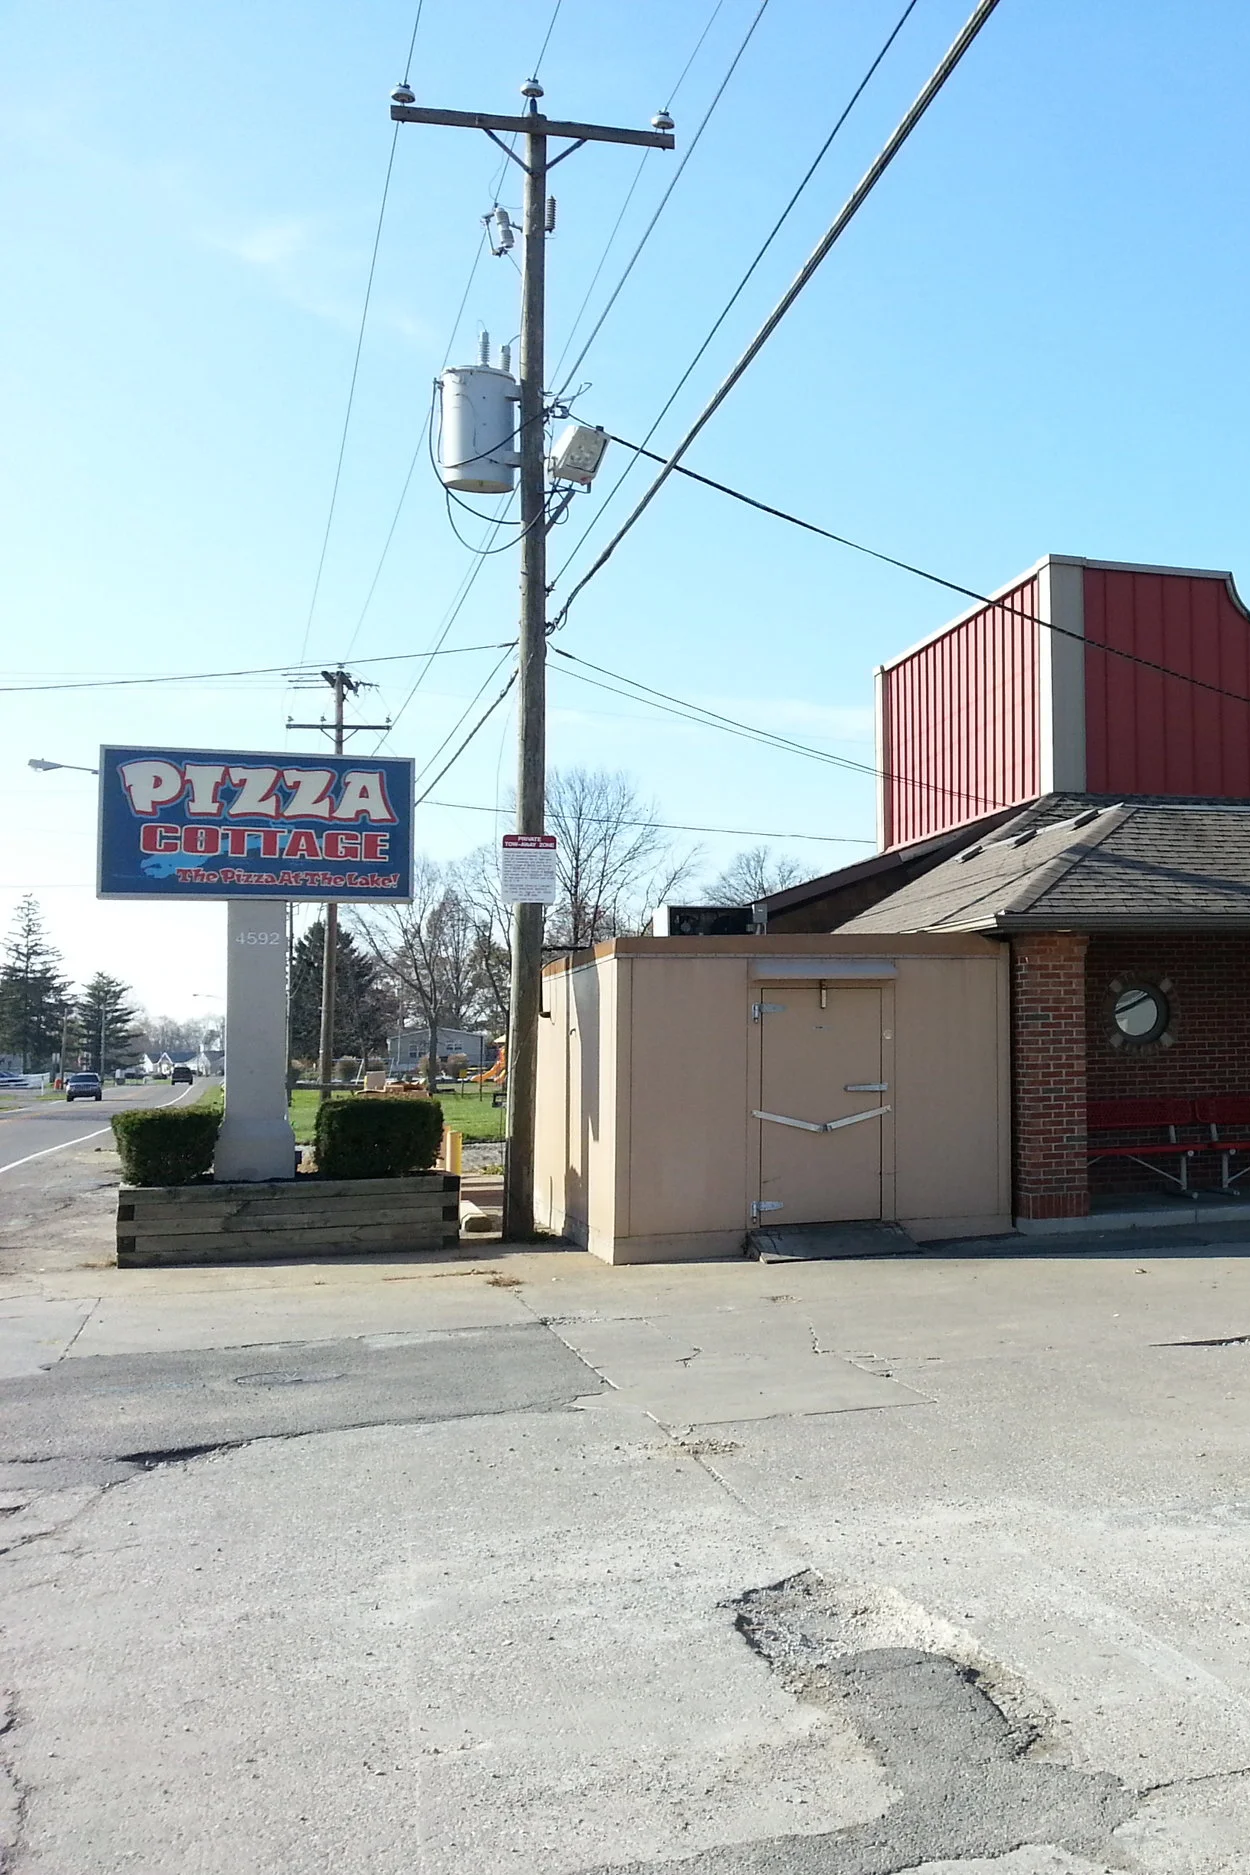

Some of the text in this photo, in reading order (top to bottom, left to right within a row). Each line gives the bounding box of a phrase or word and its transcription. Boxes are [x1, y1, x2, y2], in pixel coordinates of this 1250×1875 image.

[119, 759, 397, 823] PIZZA
[141, 823, 390, 862] COTTAGE
[176, 868, 401, 889] The Pizza At The Lake!
[235, 931, 280, 945] 4592
